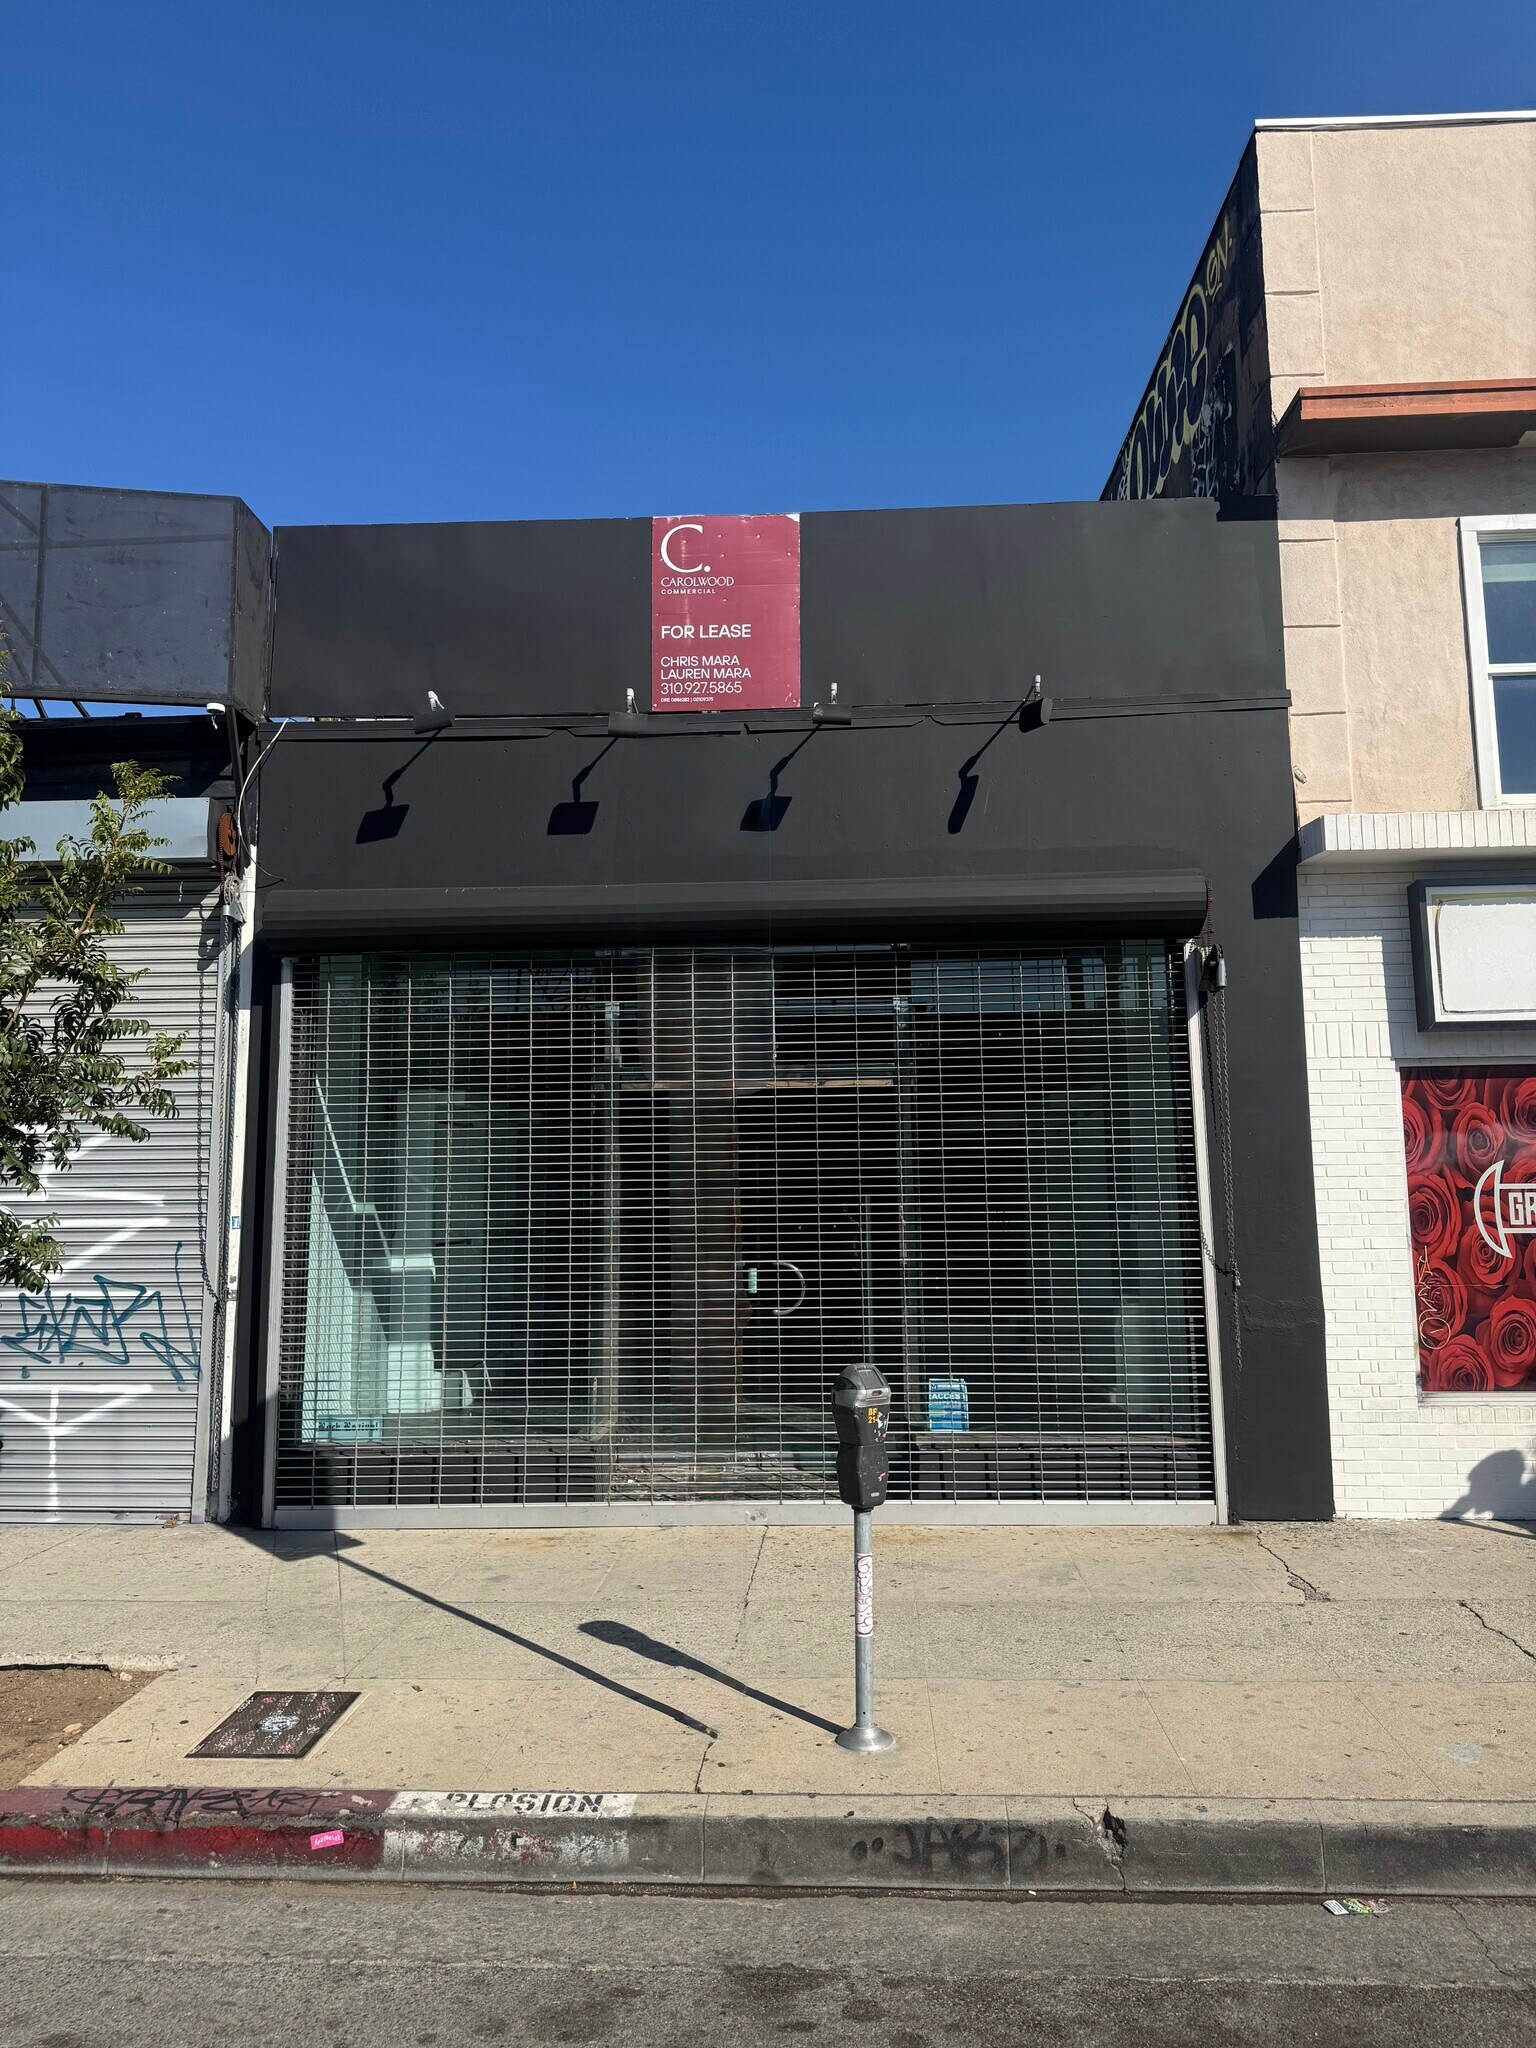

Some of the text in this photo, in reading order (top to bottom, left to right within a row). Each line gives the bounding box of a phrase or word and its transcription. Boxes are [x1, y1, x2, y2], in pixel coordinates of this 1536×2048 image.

[661, 576, 734, 587] CAROLWOOD
[661, 624, 751, 639] FOR LEASE
[660, 655, 740, 667] CHRIS MARA
[660, 667, 752, 680] LAUREN MARA
[660, 681, 743, 695] 310.927.5865
